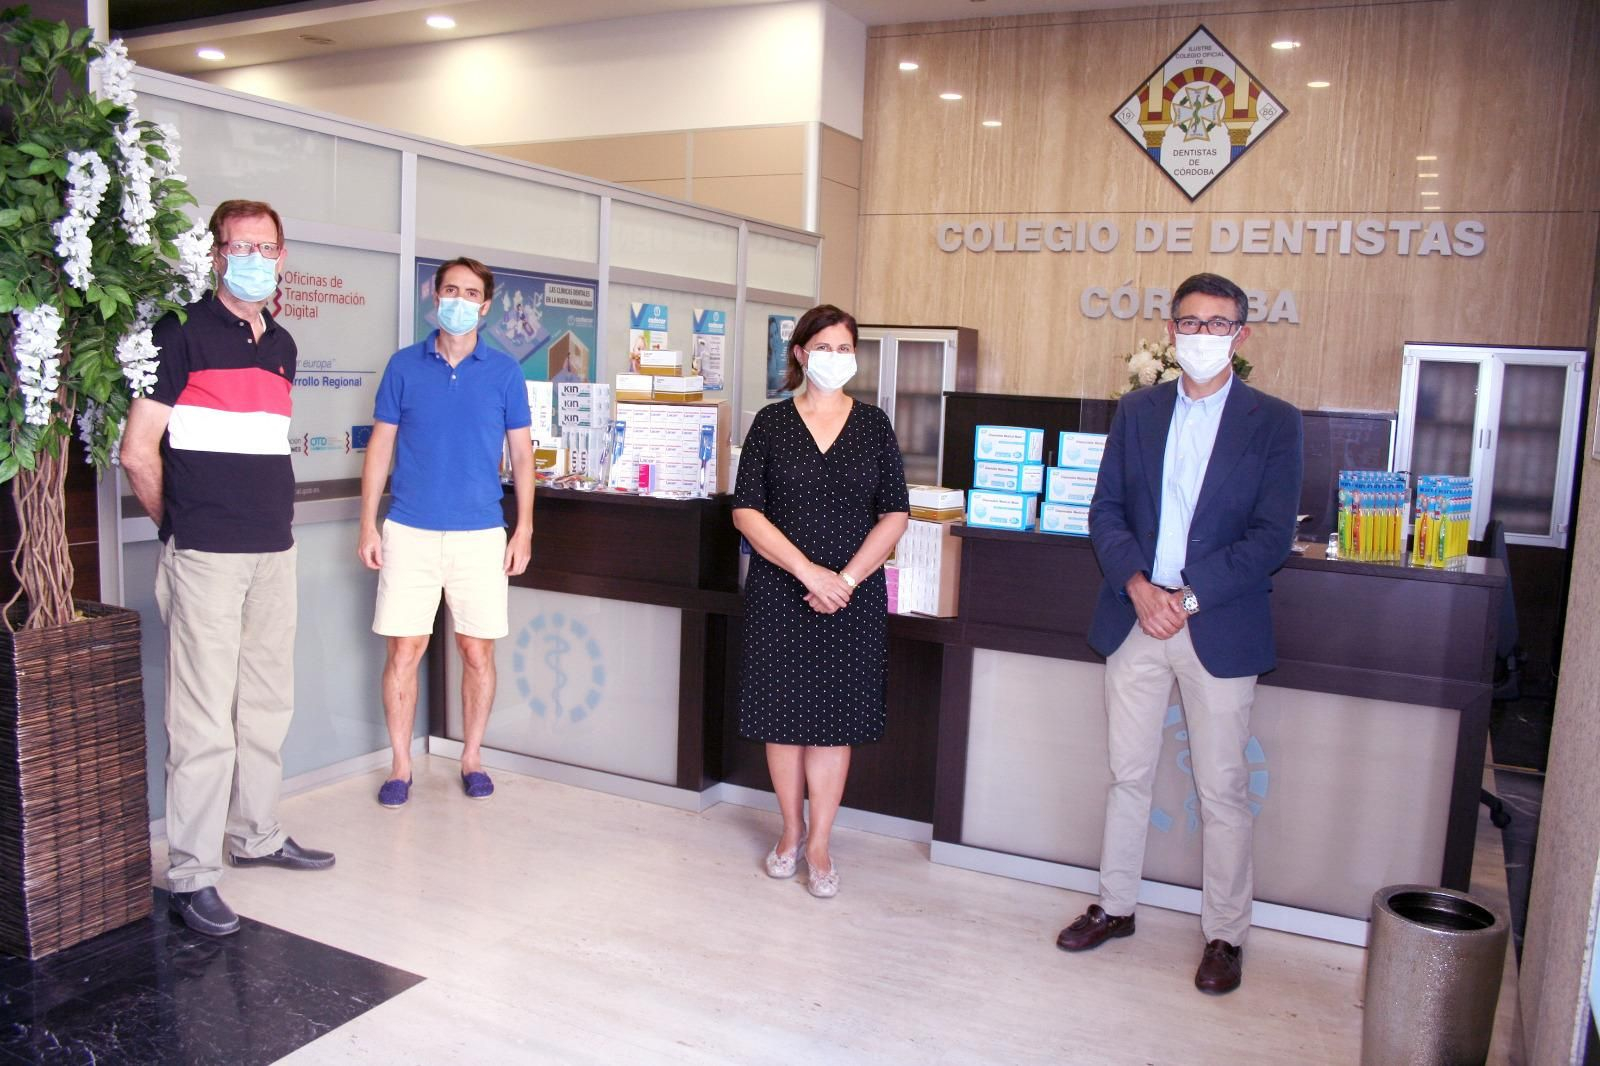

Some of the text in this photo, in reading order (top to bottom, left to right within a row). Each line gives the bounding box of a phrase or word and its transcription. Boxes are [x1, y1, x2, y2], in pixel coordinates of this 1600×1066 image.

[937, 220, 1486, 257] COLEGIO DE DENTISTAS
[284, 271, 342, 288] Oficinas de
[285, 288, 365, 305] Transformación
[1080, 280, 1299, 324] CÓRBA
[284, 304, 318, 320] Digital
[322, 376, 362, 389] Regional
